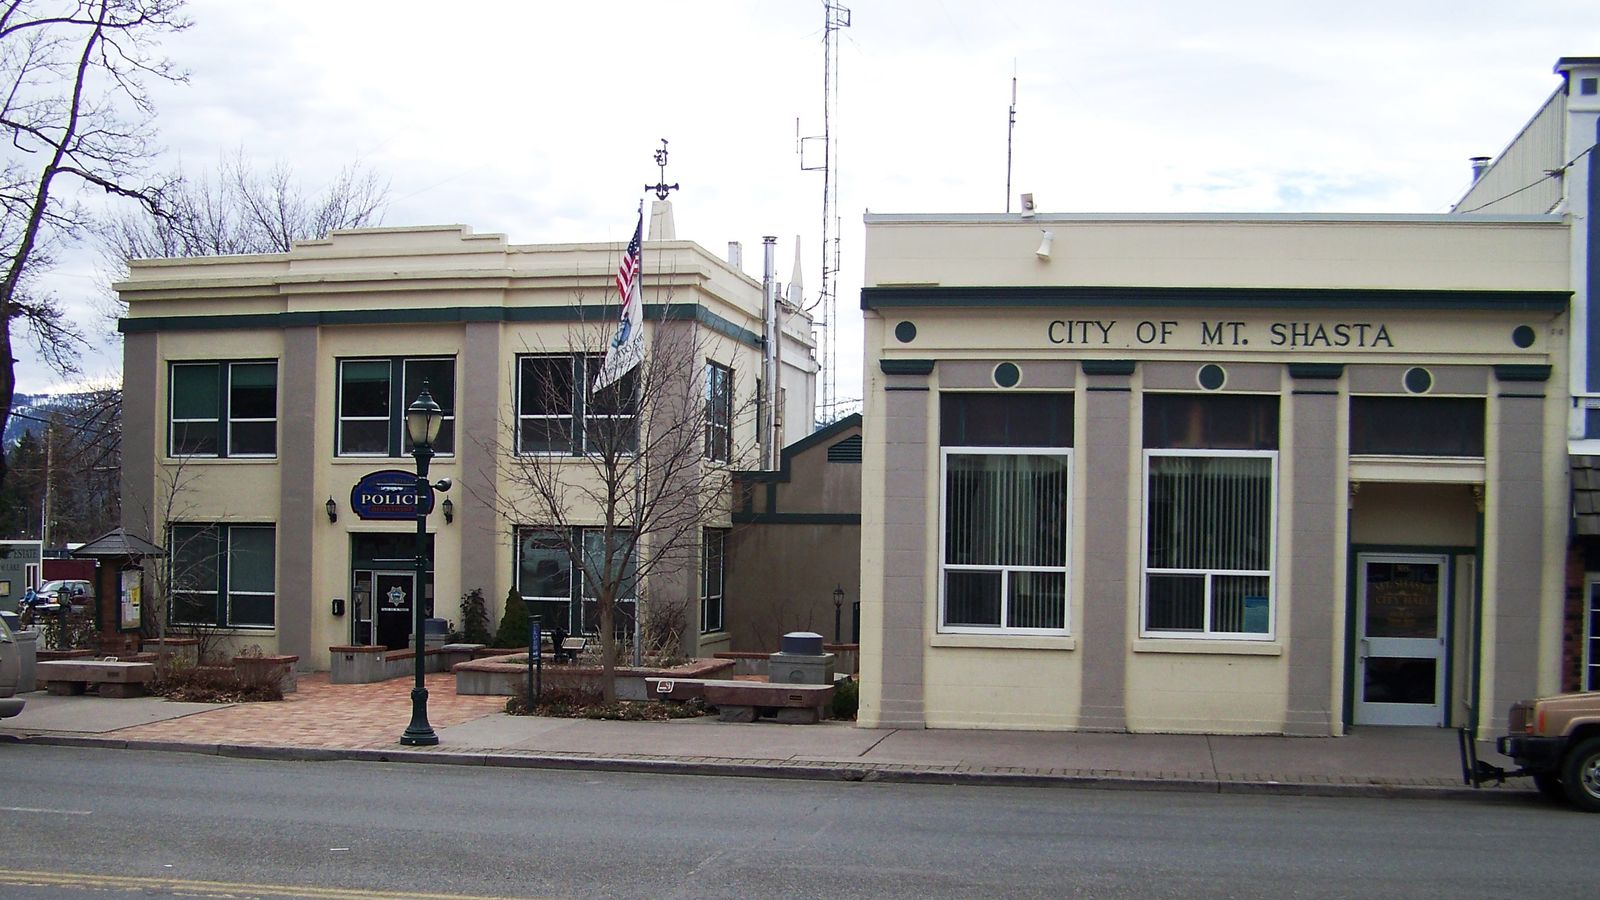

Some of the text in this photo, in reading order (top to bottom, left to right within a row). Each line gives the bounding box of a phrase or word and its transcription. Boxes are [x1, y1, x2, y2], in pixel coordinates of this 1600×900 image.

[1048, 320, 1394, 348] CITY OF MT. SHASTA
